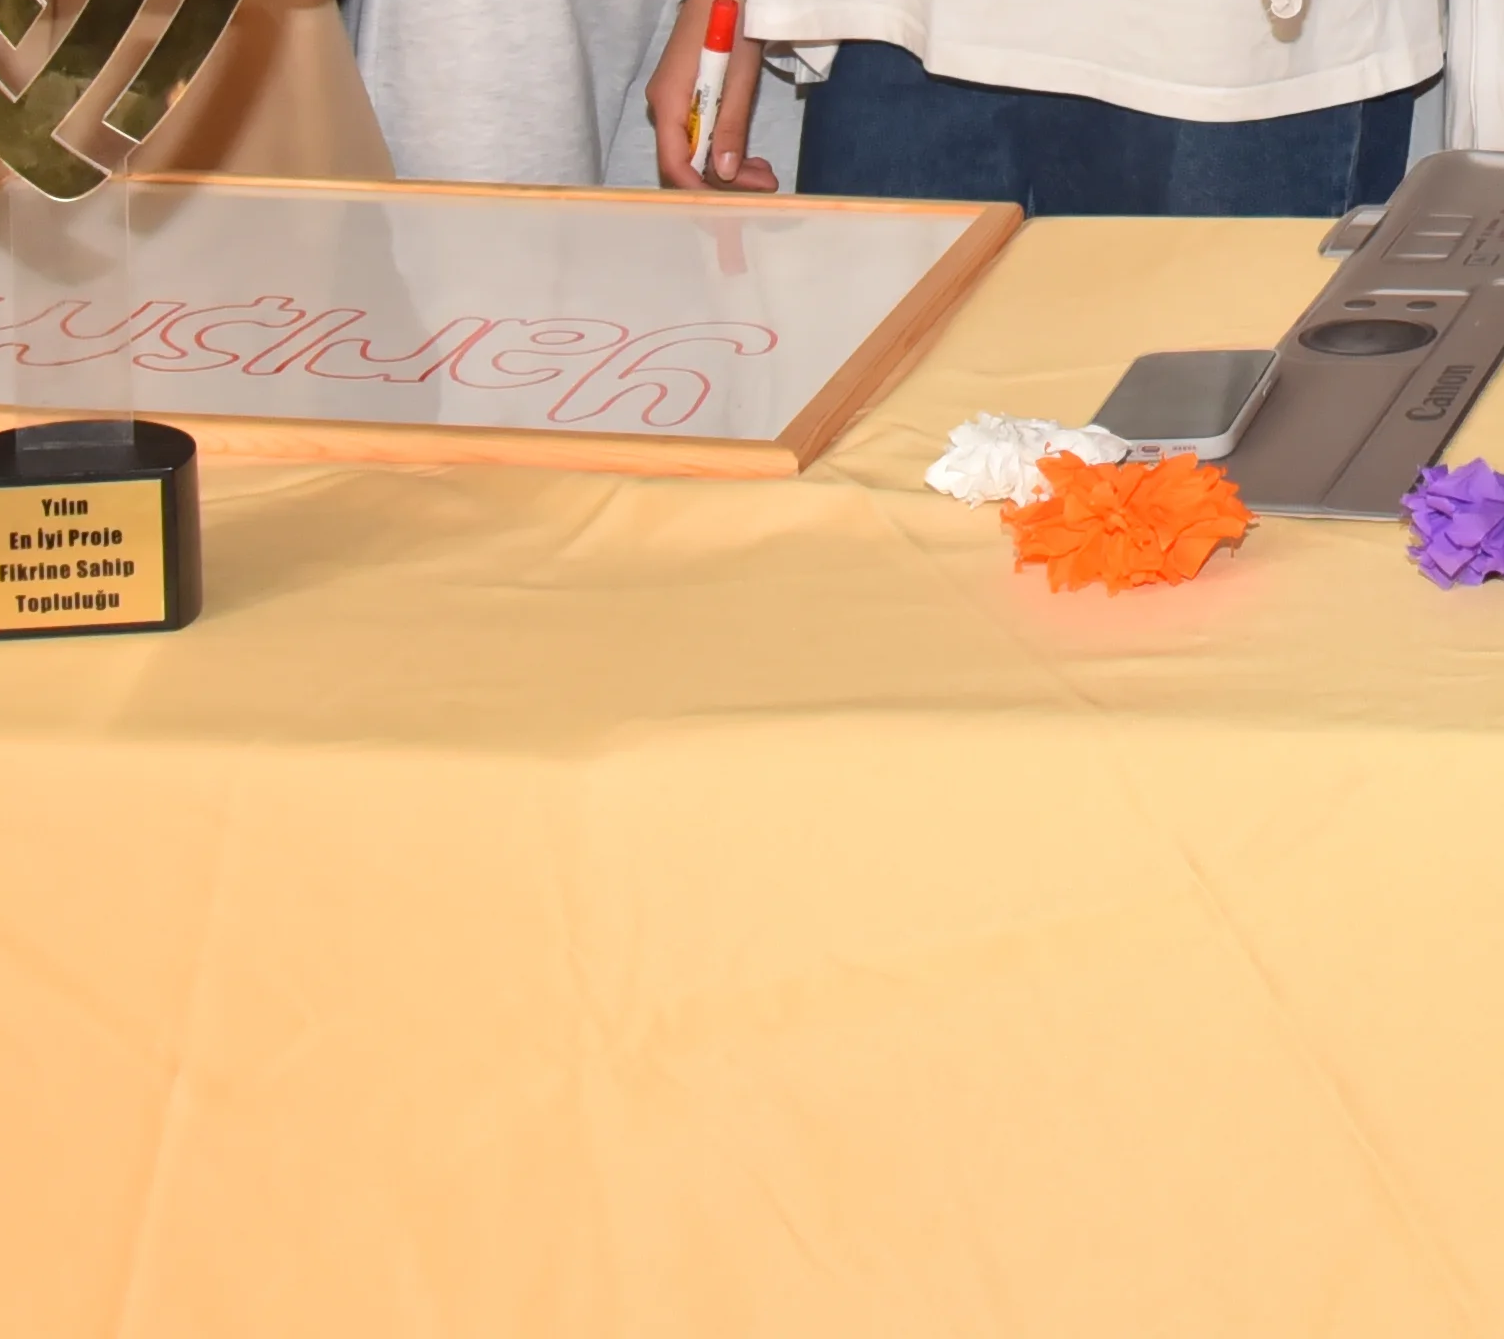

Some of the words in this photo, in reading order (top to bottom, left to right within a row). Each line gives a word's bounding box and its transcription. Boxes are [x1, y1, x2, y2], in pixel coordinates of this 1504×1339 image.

[1405, 365, 1475, 421] Canon
[41, 498, 88, 517] Yılın
[9, 532, 32, 550] En
[37, 527, 63, 550] İyi
[68, 527, 123, 548] Proje
[0, 562, 71, 582] Fikrine
[76, 558, 135, 578] Sahip
[15, 590, 120, 613] Topluluğu
